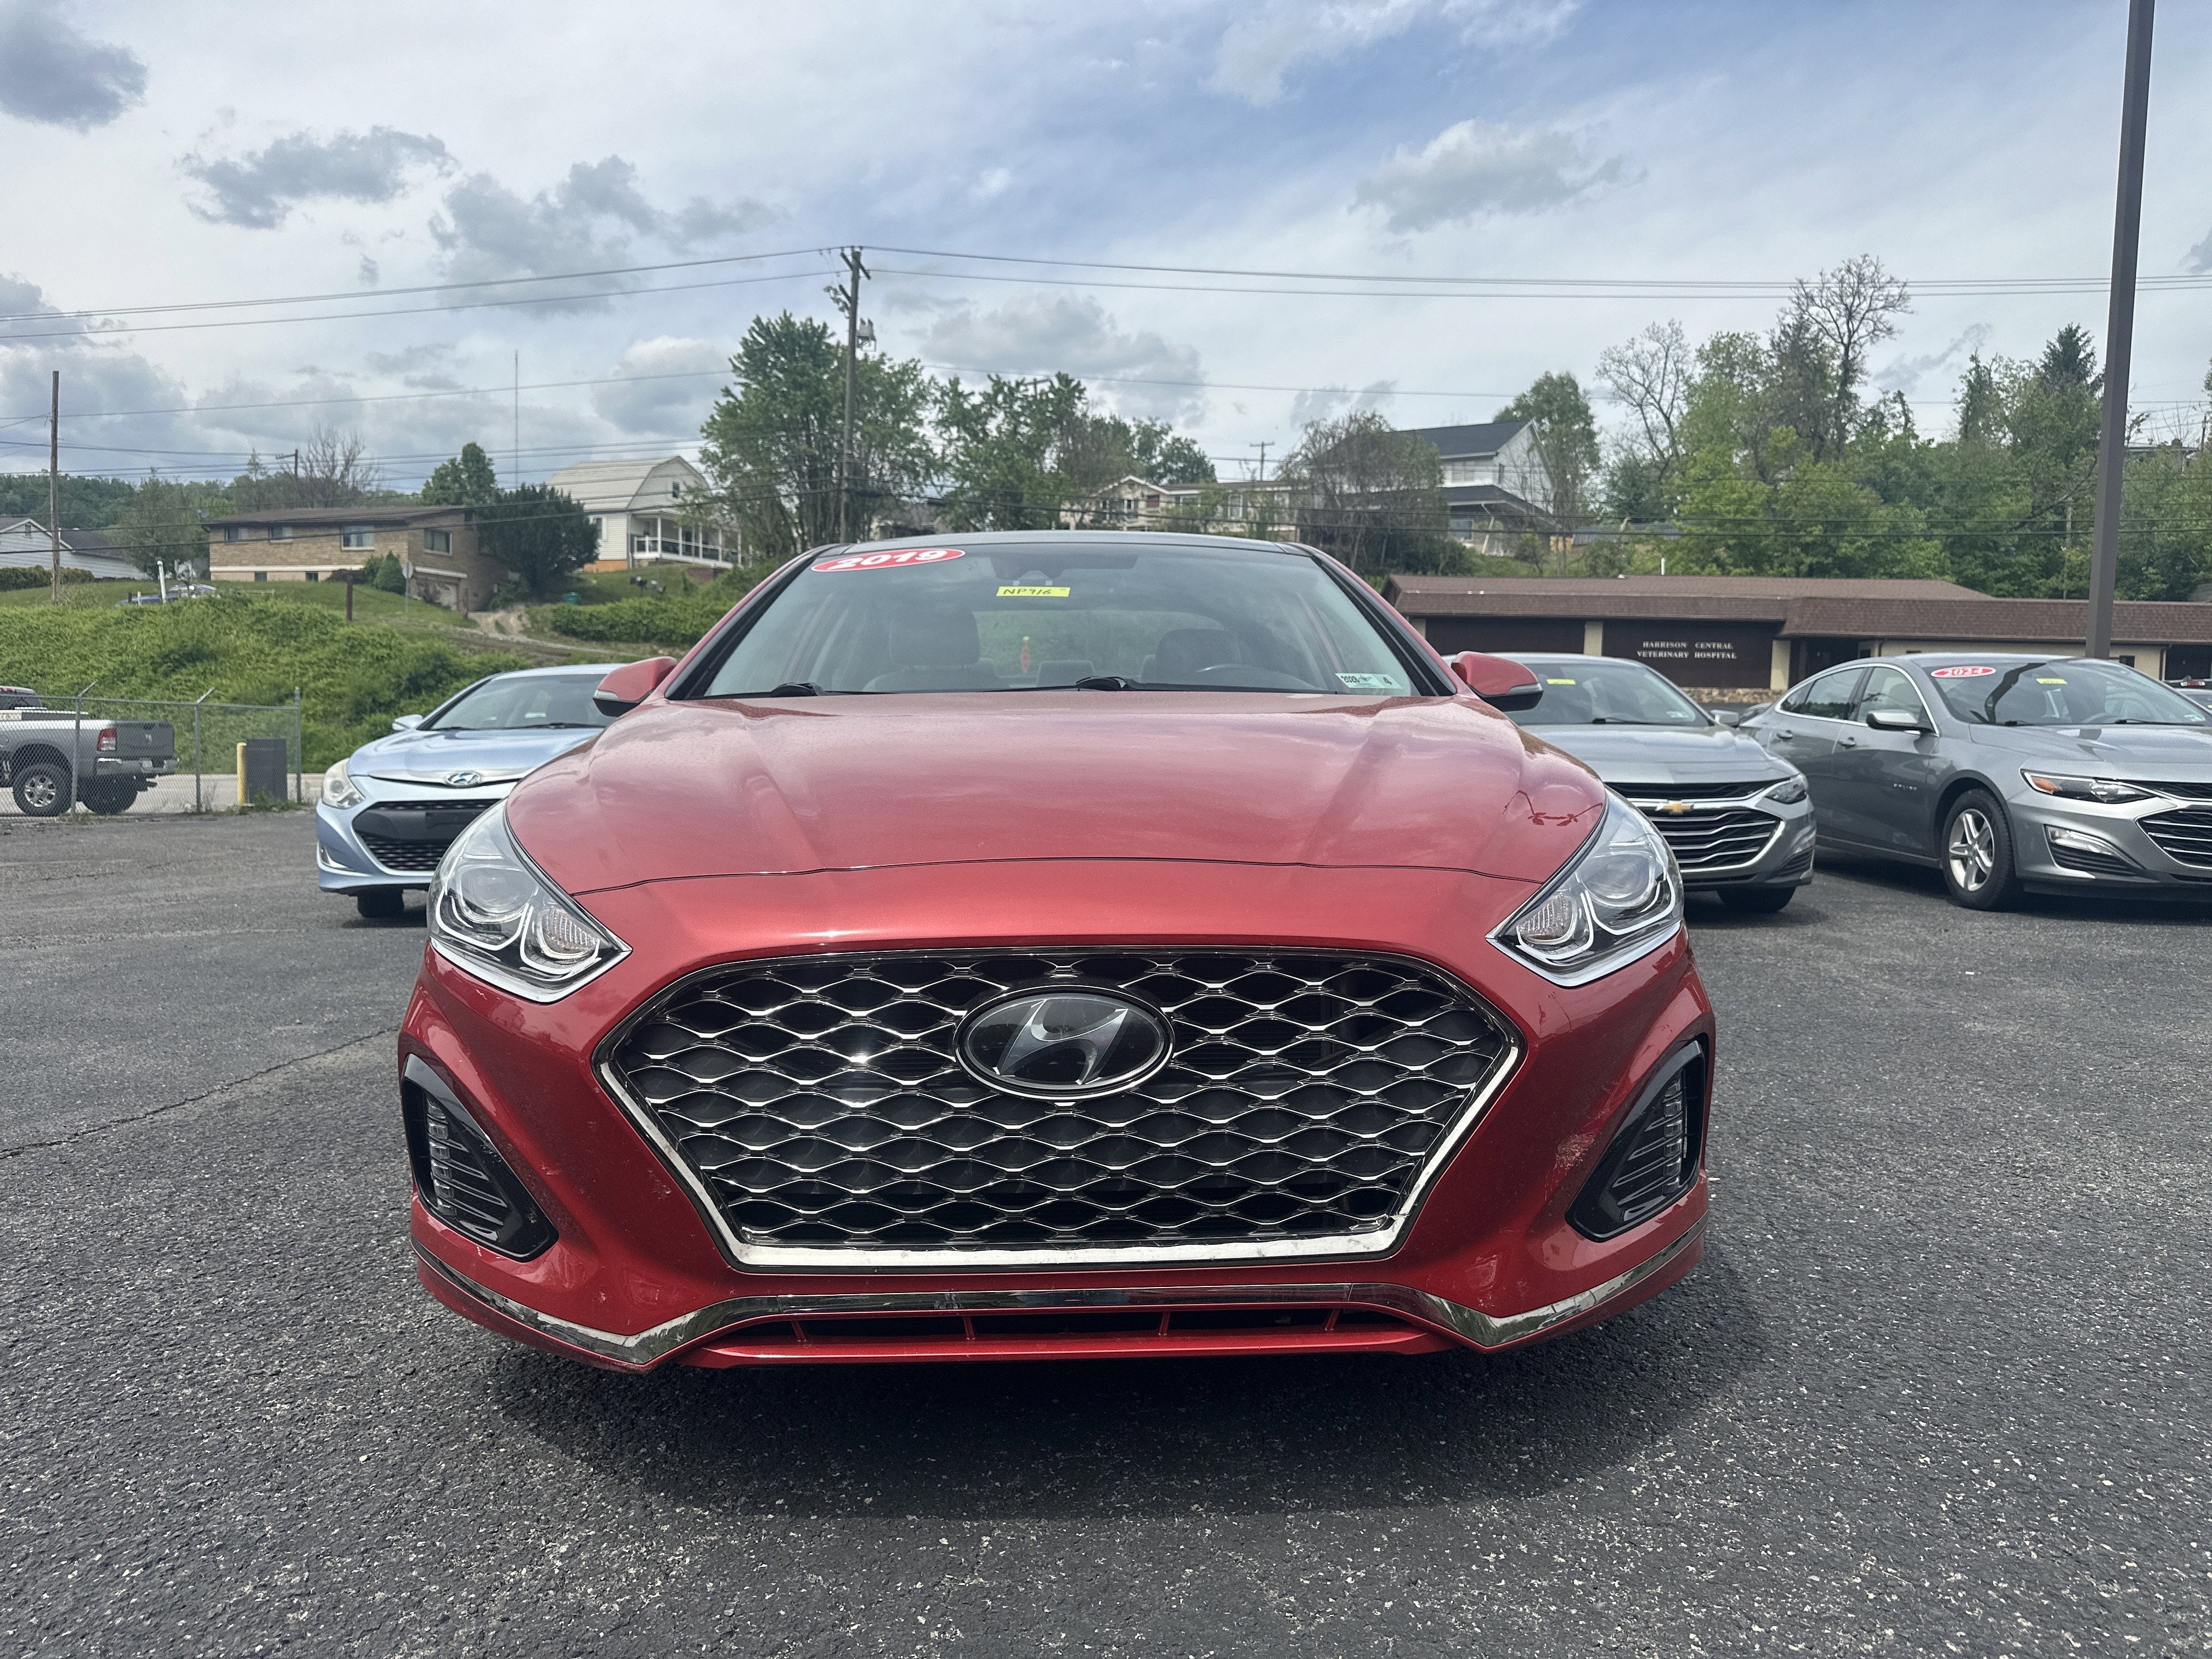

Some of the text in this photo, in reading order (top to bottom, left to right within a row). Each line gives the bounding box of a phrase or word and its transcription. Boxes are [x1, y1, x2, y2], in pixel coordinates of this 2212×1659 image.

[827, 550, 947, 571] 2019
[1695, 641, 1734, 650] CENTRAL
[1637, 650, 1737, 659] VETERINARY HOSPITAL
